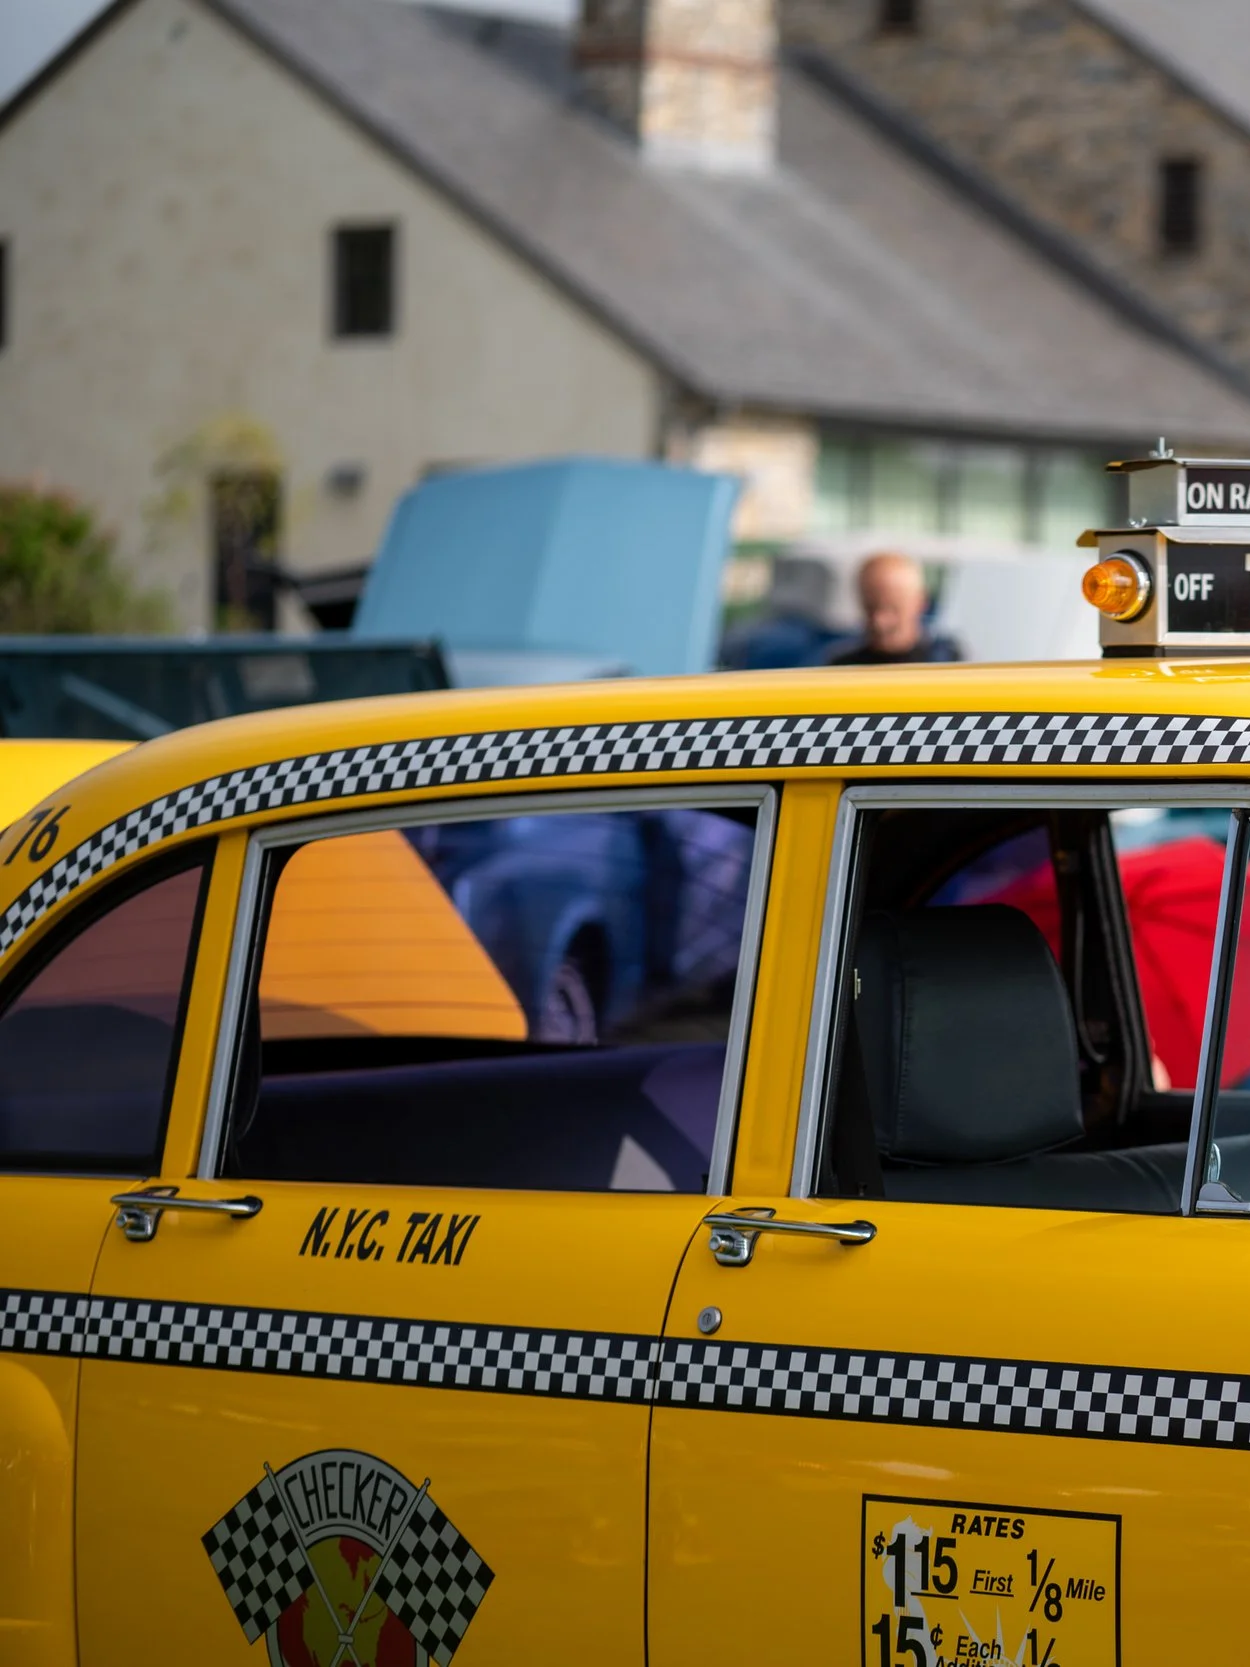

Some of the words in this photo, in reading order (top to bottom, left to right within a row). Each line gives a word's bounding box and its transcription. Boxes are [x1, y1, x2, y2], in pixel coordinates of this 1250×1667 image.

[1187, 482, 1224, 511] ON
[1174, 573, 1214, 601] OFF
[298, 1206, 389, 1262] N.Y.C.
[396, 1212, 481, 1266] TAXI
[283, 1461, 408, 1541] CHECKER
[951, 1513, 1026, 1540] RATES
[972, 1569, 1014, 1593] First
[1065, 1578, 1106, 1601] Mile
[956, 1635, 1002, 1661] Each
